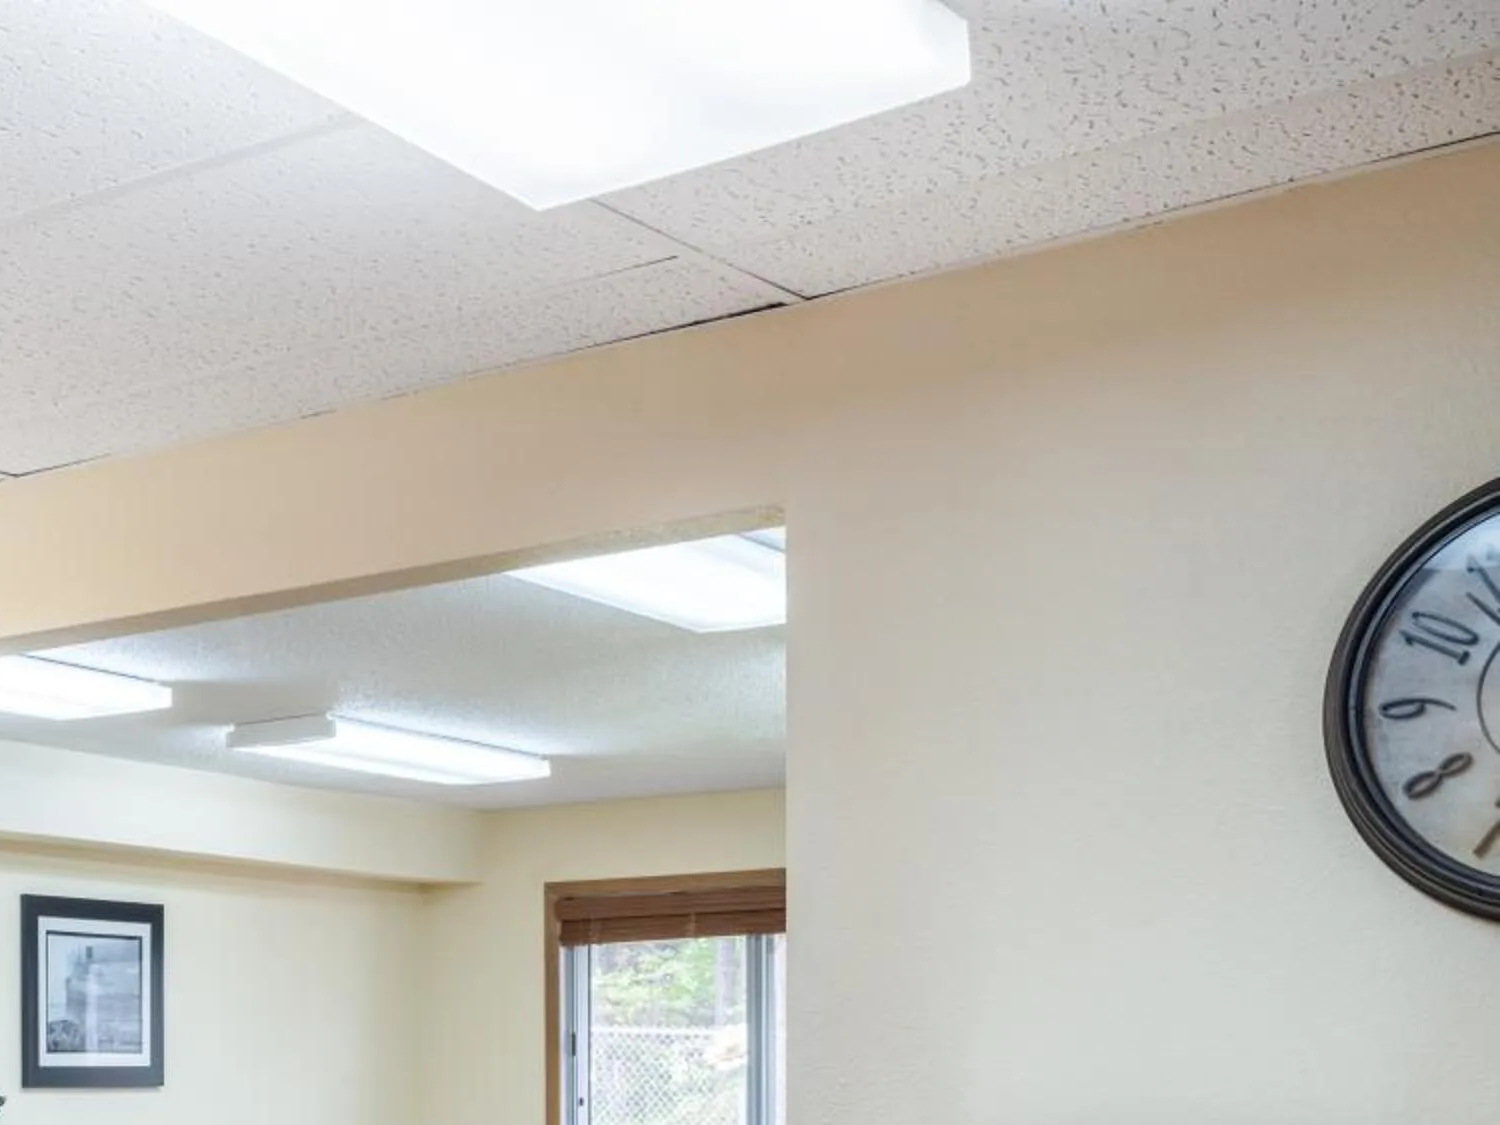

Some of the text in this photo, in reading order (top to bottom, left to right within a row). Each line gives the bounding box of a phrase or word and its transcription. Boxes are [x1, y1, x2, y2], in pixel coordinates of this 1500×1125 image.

[1400, 612, 1479, 665] 10
[1380, 697, 1457, 719] 9
[1402, 752, 1473, 799] 8
